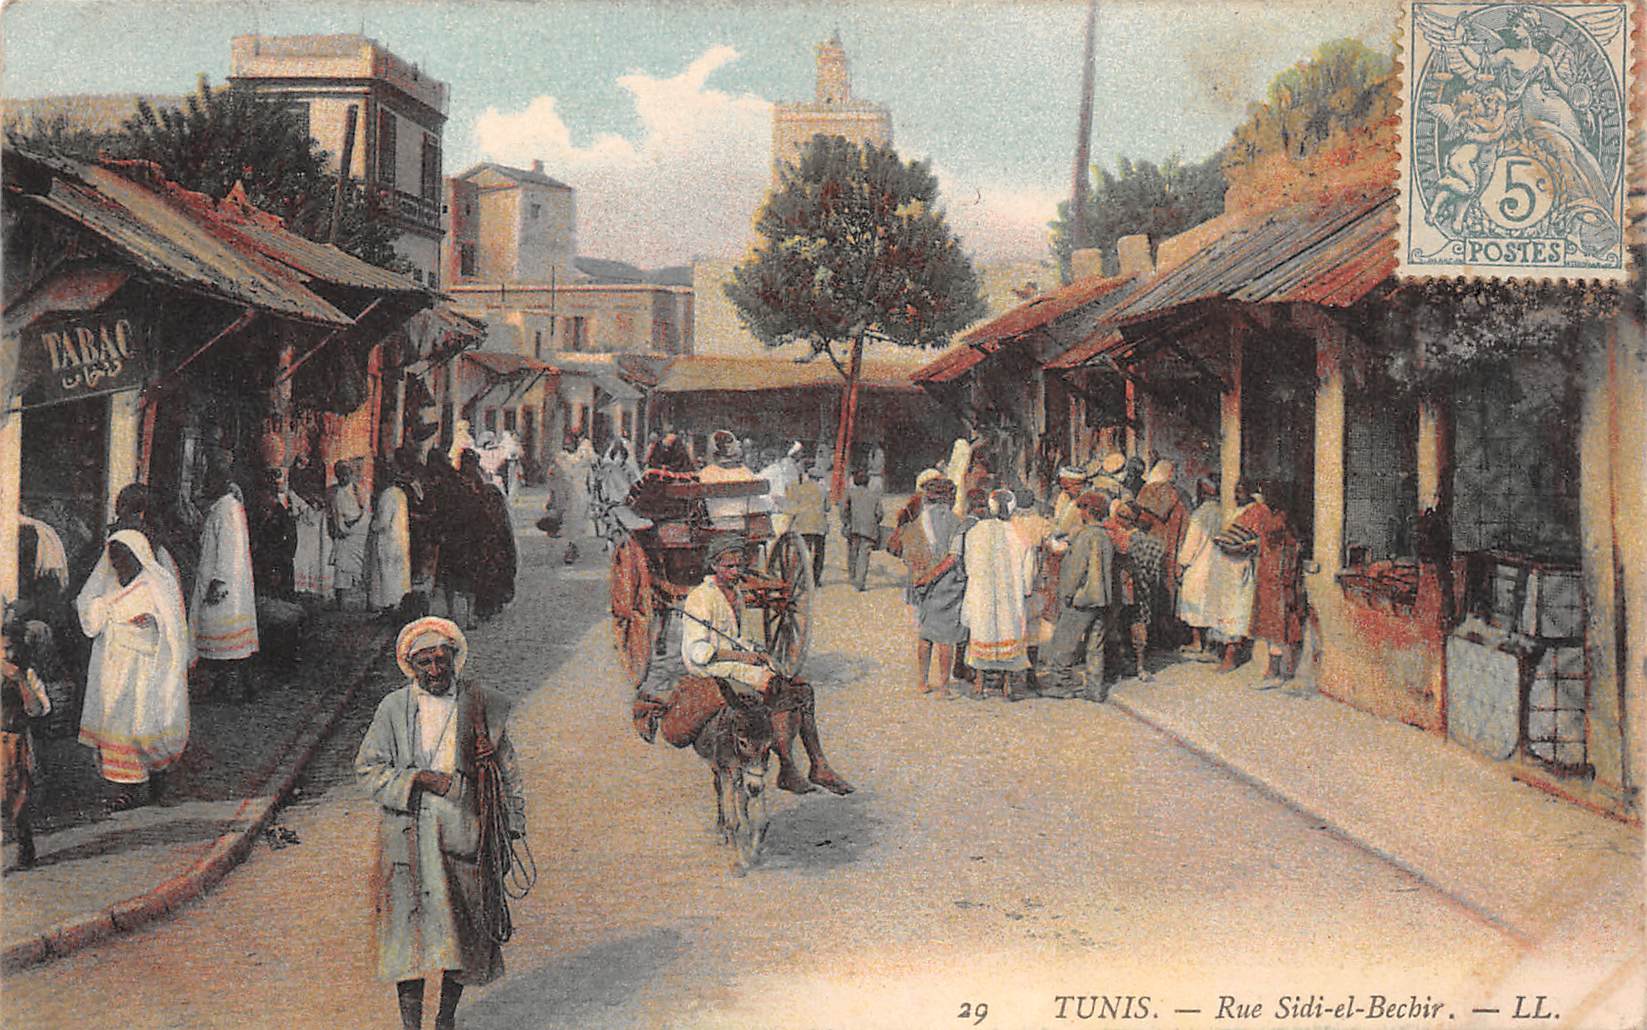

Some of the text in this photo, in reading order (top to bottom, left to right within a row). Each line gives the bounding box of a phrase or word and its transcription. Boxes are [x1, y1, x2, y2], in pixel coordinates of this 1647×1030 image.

[1499, 160, 1536, 222] 5
[1468, 241, 1561, 263] POSTES
[41, 319, 135, 370] TABAC
